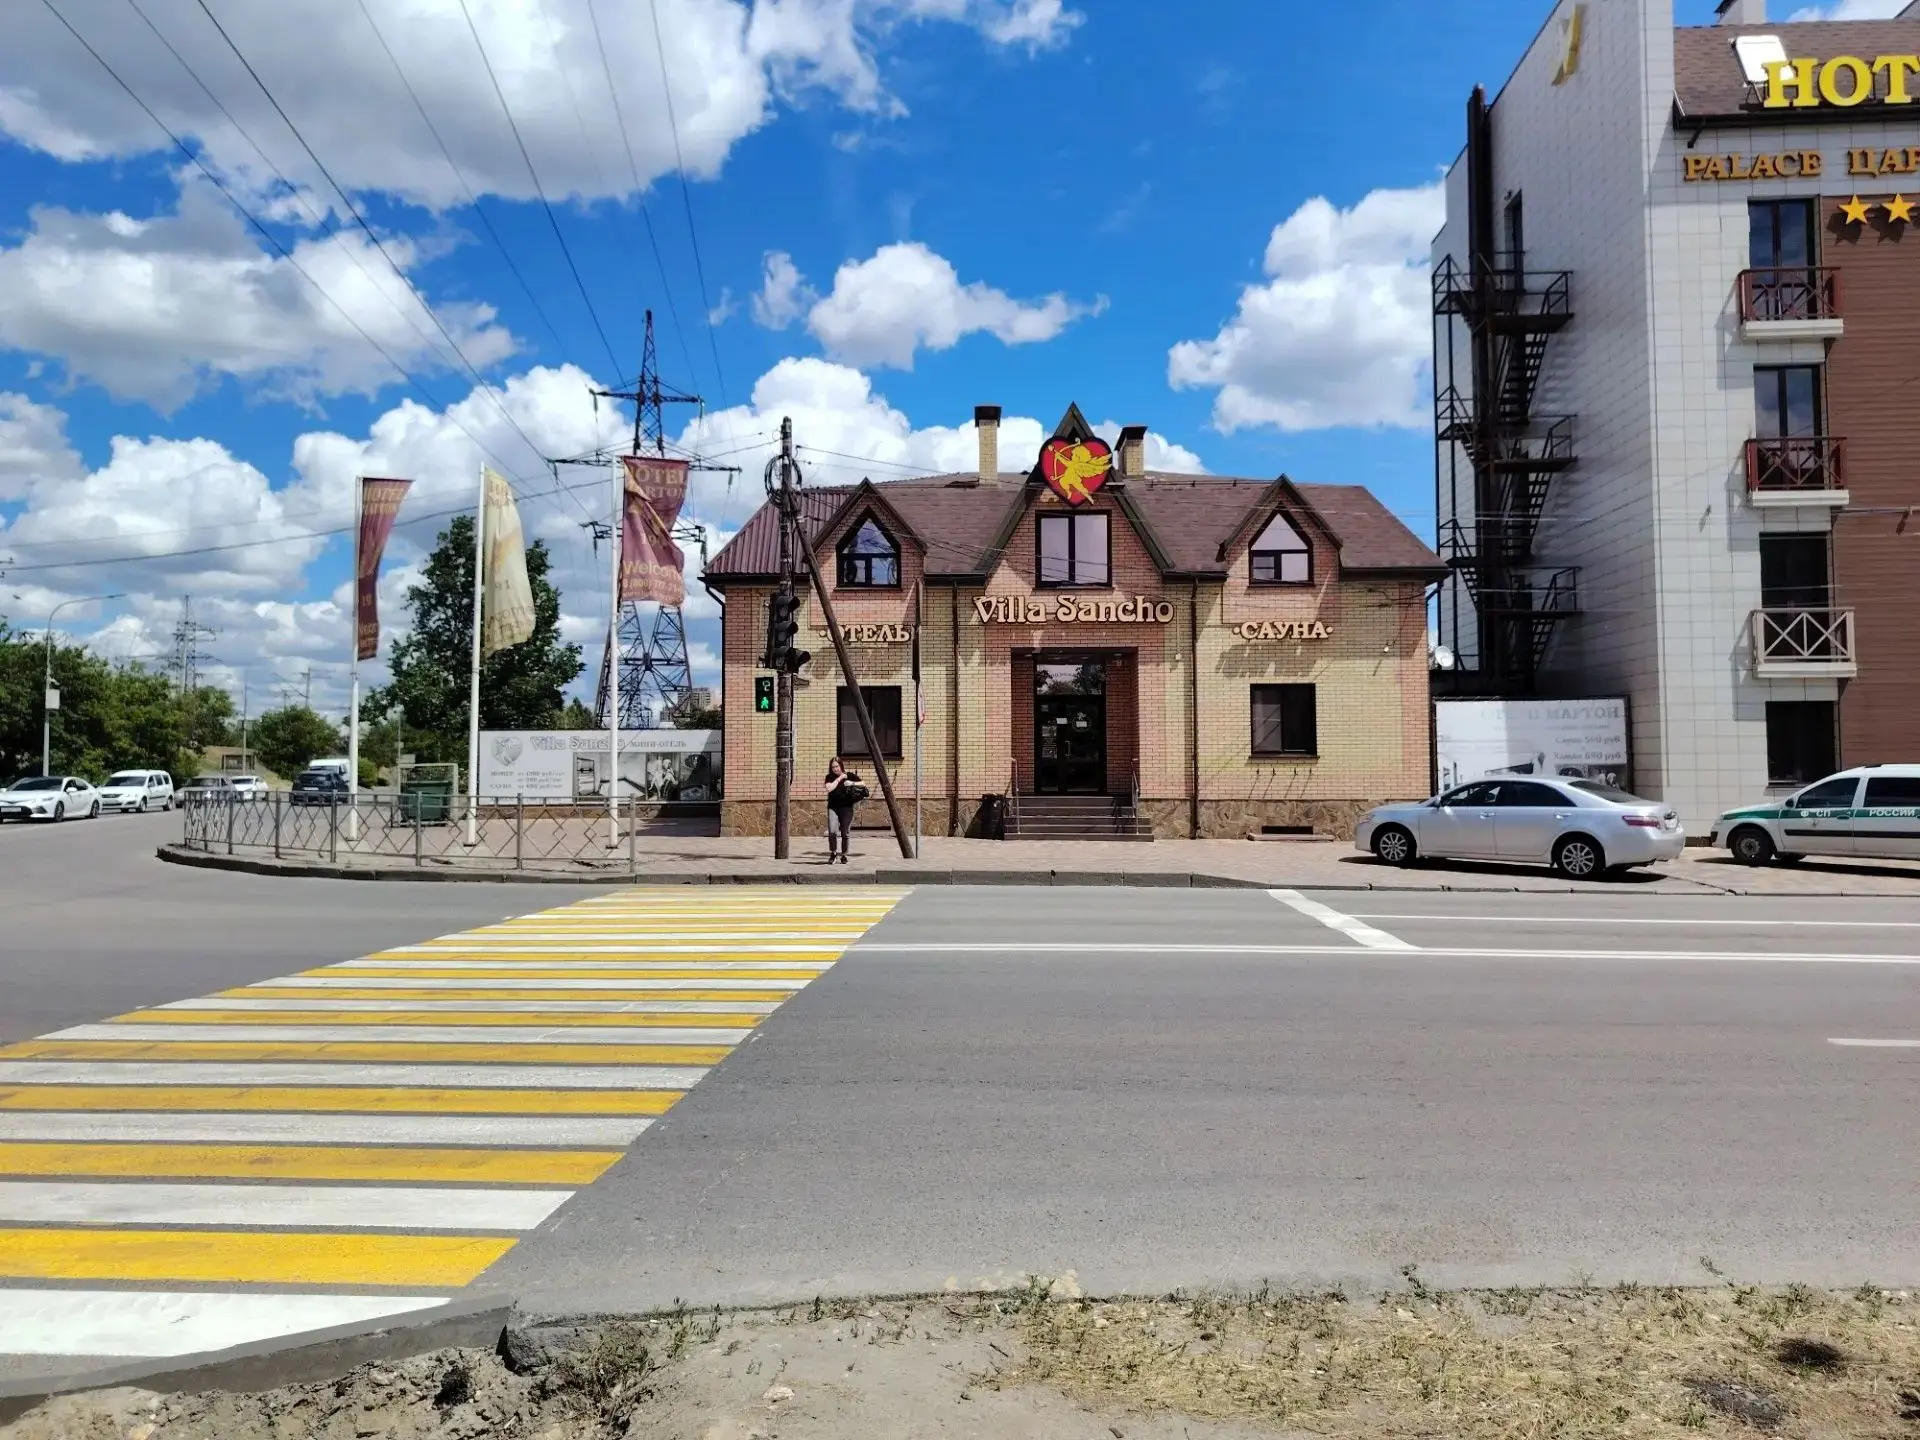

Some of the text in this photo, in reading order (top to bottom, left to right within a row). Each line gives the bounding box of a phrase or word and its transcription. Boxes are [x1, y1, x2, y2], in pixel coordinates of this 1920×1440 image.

[1762, 55, 1920, 108] HOT
[1684, 149, 1823, 181] PALACE
[973, 594, 1174, 623] Villa Sancho
[1241, 620, 1329, 640] САУНА
[569, 735, 626, 751] Sanco
[1868, 807, 1916, 818] РОССИИ
